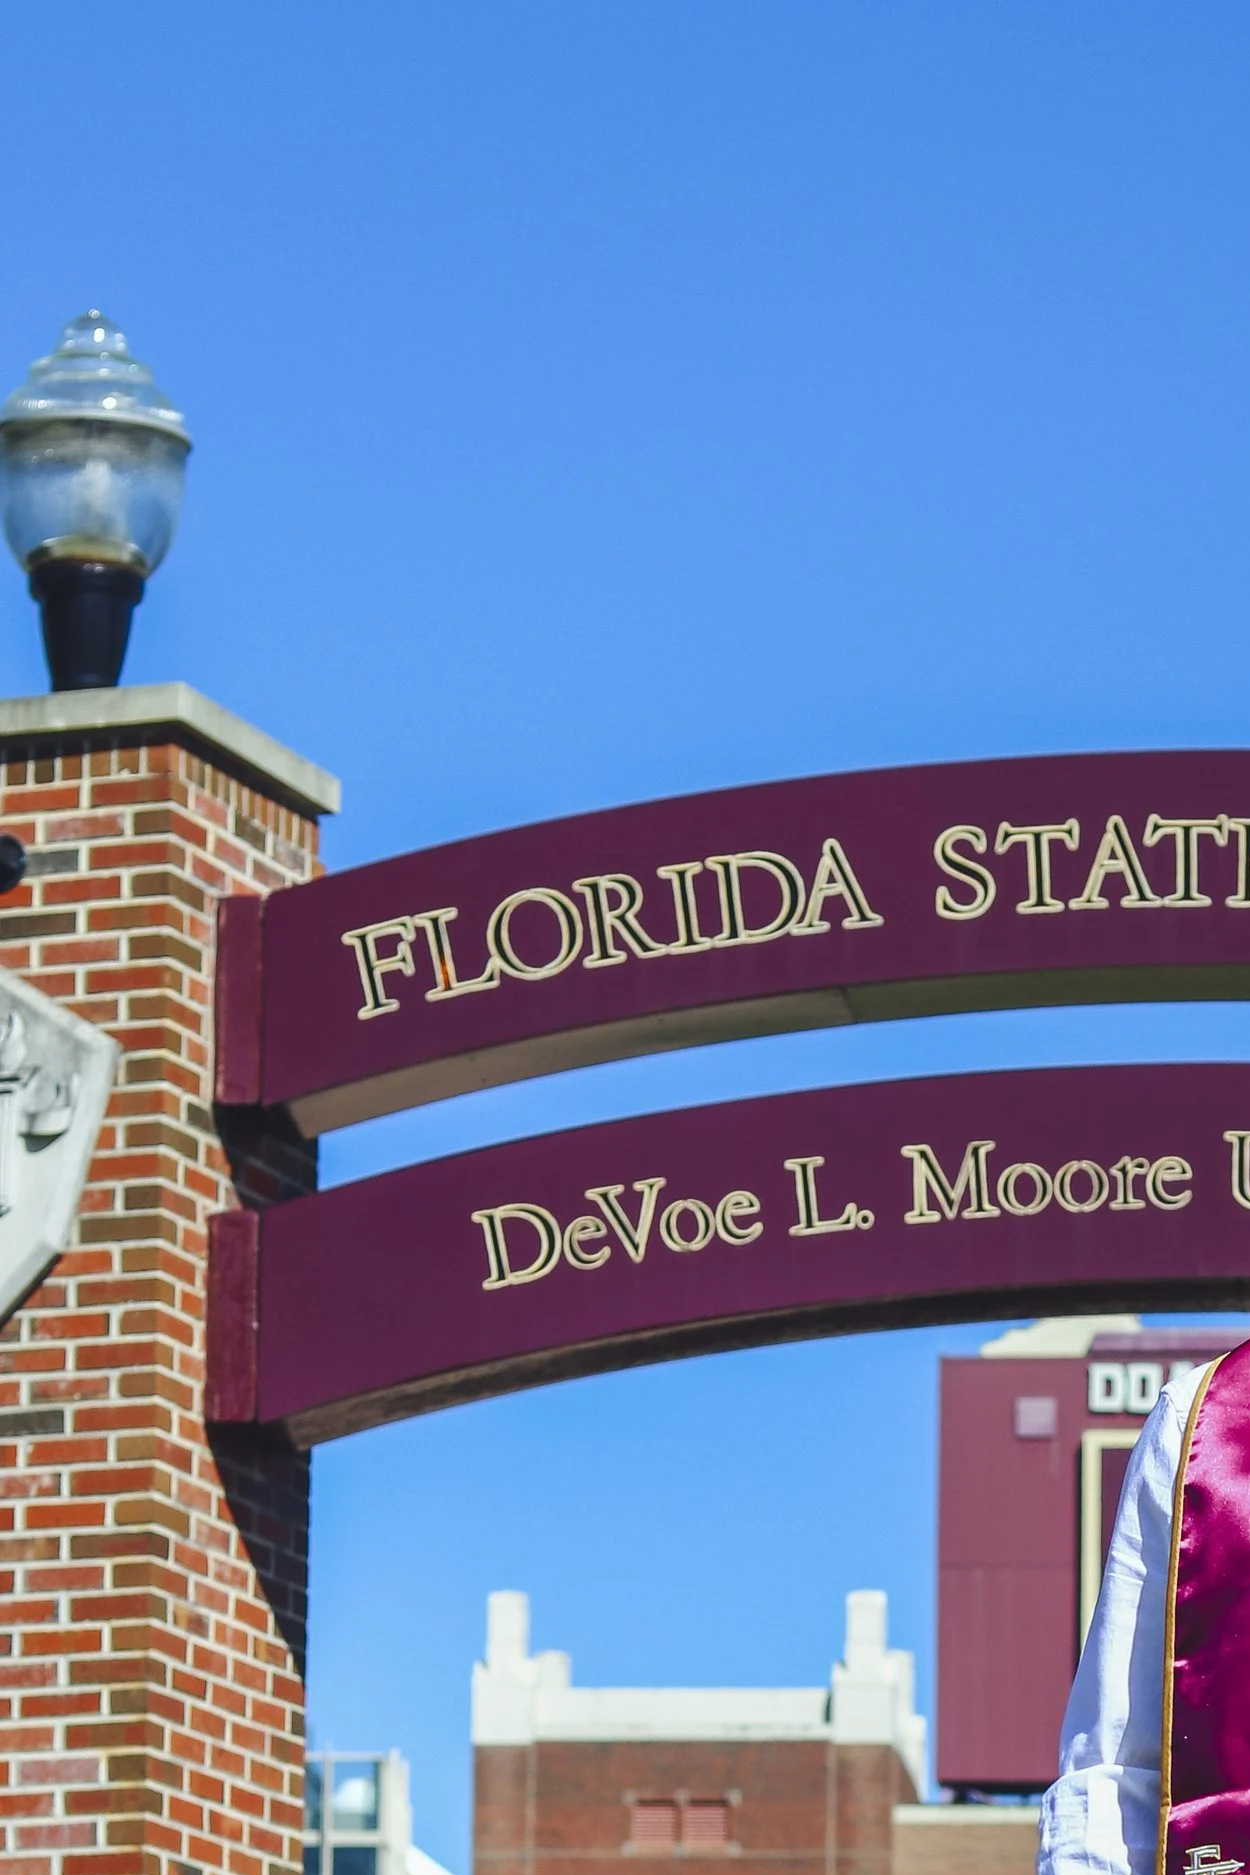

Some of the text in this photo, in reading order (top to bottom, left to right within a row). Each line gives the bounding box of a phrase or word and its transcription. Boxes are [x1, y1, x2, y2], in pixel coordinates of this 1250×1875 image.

[342, 838, 883, 1019] FLORIDA
[472, 1177, 764, 1290] DeVoe
[785, 1155, 875, 1237] L.
[901, 1141, 1193, 1223] Moore
[1088, 1361, 1195, 1414] DO
